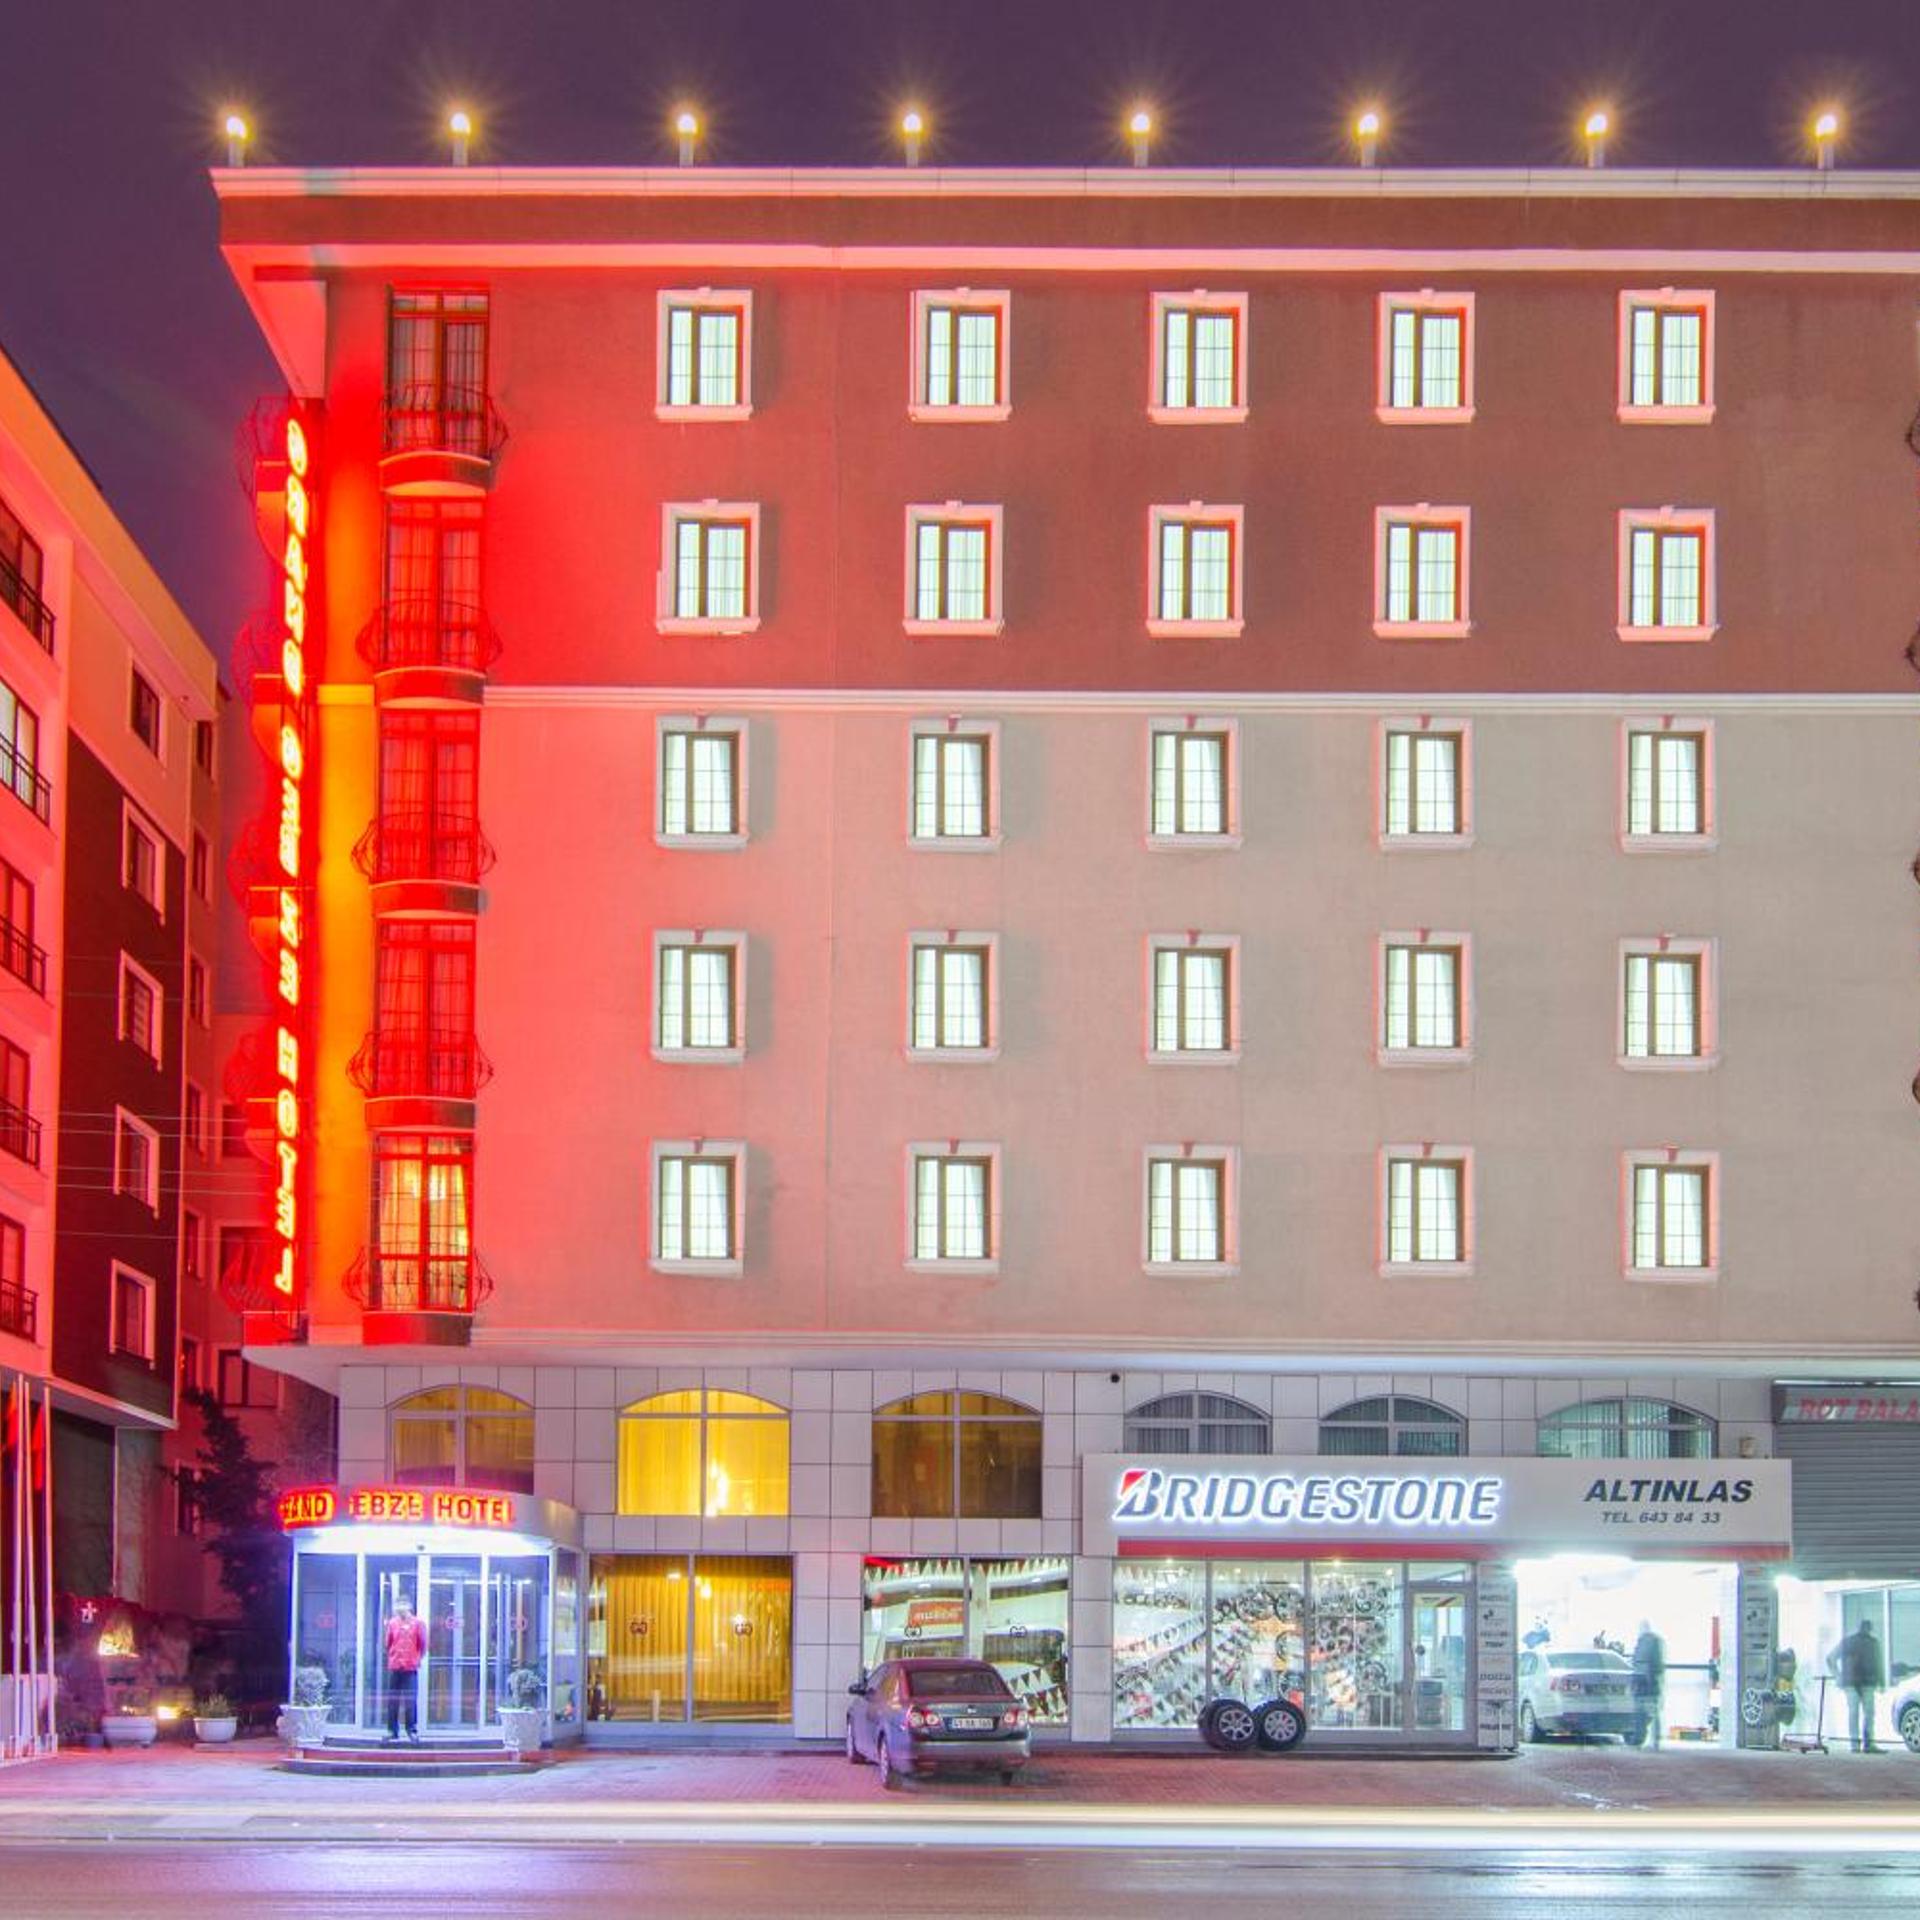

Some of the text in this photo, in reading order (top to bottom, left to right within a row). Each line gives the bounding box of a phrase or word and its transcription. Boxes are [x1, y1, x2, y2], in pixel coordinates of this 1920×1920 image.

[274, 1026, 299, 1295] HOTEL
[1113, 1468, 1502, 1521] BRIDGESTONE
[1584, 1479, 1754, 1503] ALTINLAS
[1639, 1512, 1668, 1524] 643
[1674, 1512, 1693, 1524] 84
[1700, 1512, 1721, 1524] 33
